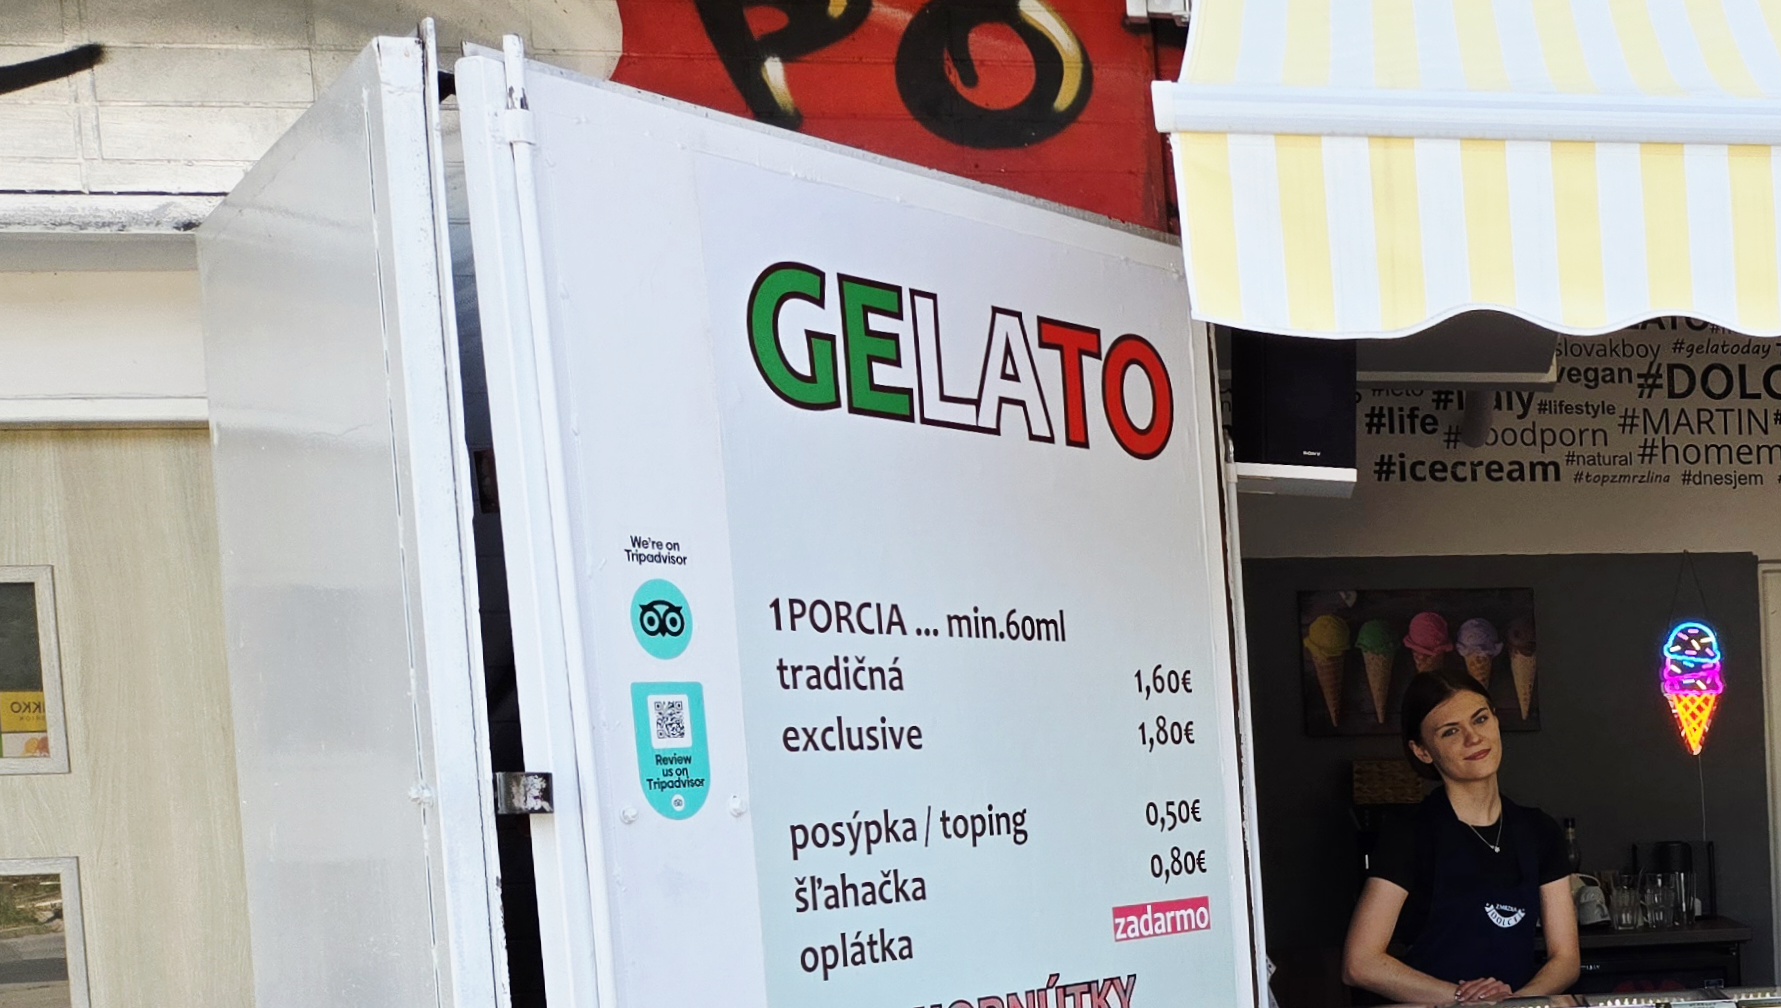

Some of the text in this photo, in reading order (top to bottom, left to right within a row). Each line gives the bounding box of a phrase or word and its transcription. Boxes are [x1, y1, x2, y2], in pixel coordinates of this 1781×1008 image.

[746, 261, 1174, 460] GELATO
[1556, 338, 1660, 362] slovakboy
[1672, 338, 1771, 359] #gelatoday
[1556, 366, 1633, 389] vegan
[1537, 399, 1616, 418] #lifestyle
[1364, 405, 1439, 435] #life
[1443, 421, 1608, 454] #oodporn
[1617, 406, 1769, 436] #MARTIN
[1373, 453, 1561, 483] #icecream
[1565, 451, 1633, 467] #natural
[1573, 470, 1670, 487] #topzmrzlina
[1681, 470, 1764, 489] #dnesjem
[624, 549, 688, 566] Tripadvisor
[630, 535, 680, 551] We're on
[768, 597, 908, 636] 1PORCIA
[946, 605, 1067, 643] min.60ml
[776, 655, 904, 692] tradičná
[1134, 664, 1193, 700] 1,60€
[782, 716, 923, 752] exclusive
[1137, 715, 1195, 753] 1,80€
[655, 753, 692, 767] Review
[662, 766, 689, 779] us on
[646, 777, 705, 792] Tripadvisor
[790, 809, 918, 860] posýpka
[939, 804, 1029, 847] toping
[1145, 798, 1202, 832] 0,50€
[1150, 846, 1207, 884] 0,80€
[794, 869, 927, 913] šľahačka
[1114, 904, 1209, 941] zadarmo
[800, 928, 914, 980] oplátka
